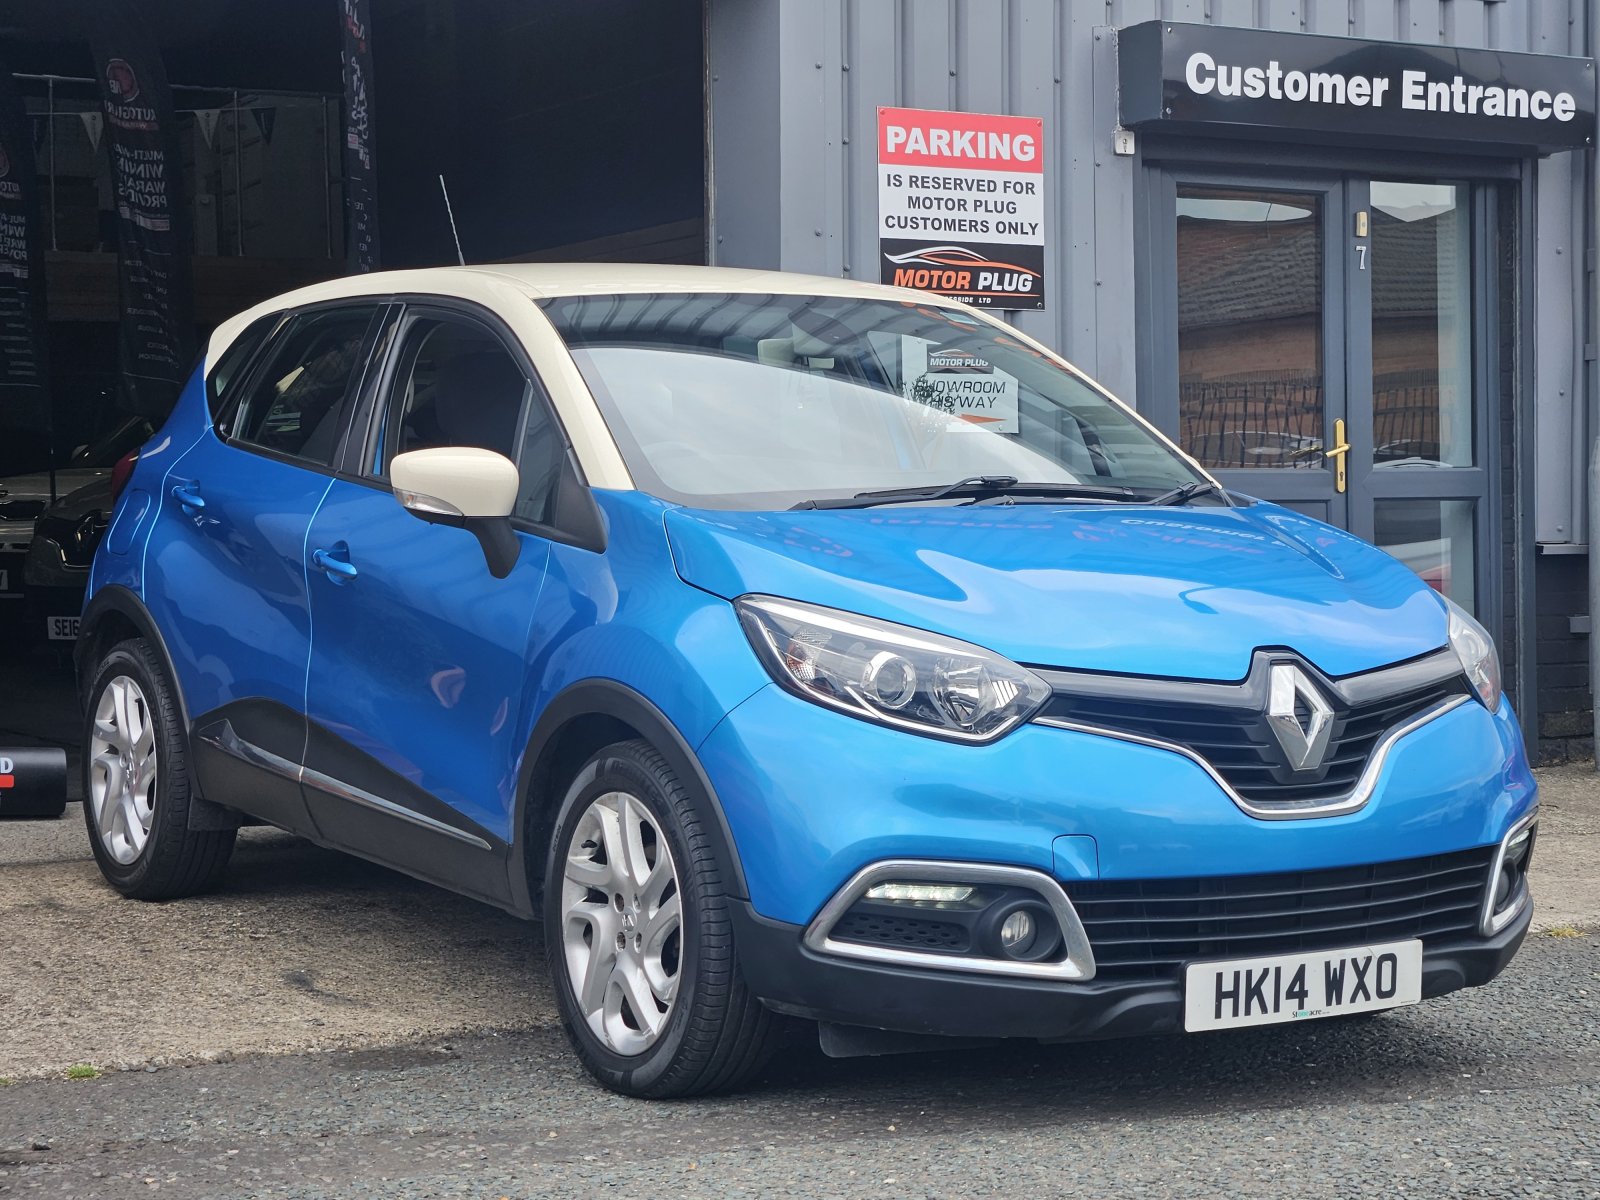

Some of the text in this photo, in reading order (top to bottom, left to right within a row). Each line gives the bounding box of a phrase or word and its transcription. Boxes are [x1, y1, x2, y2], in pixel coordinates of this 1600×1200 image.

[1185, 52, 1576, 121] Customer Entrance
[886, 125, 1036, 162] PARKING
[886, 173, 1036, 195] IS RESERVED FOR
[907, 195, 1017, 214] MOTOR PLUG
[884, 215, 1039, 236] CUSTOMERS ONLY
[1354, 245, 1367, 270] 7
[893, 268, 1033, 292] MOTOR PLUG
[930, 357, 963, 367] MOTOR
[959, 396, 997, 409] WAY
[54, 619, 80, 637] SE16
[1214, 952, 1398, 1019] HK14 WXO
